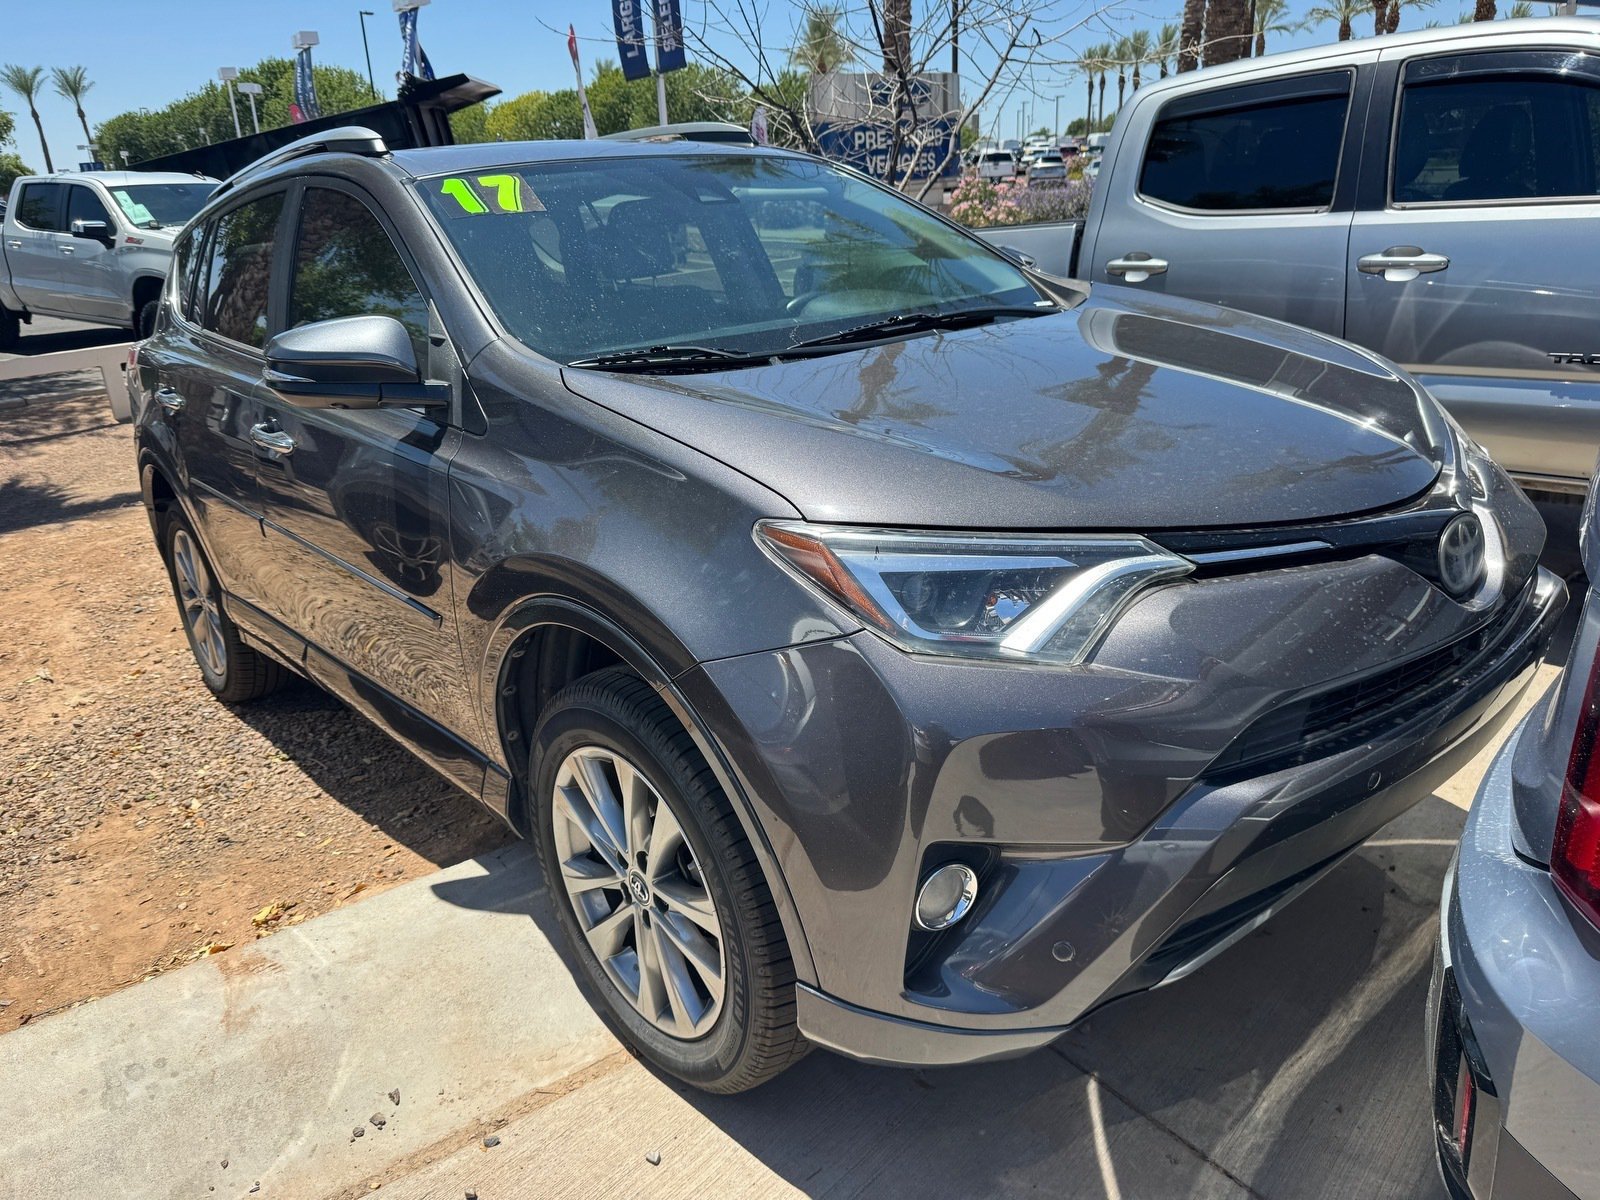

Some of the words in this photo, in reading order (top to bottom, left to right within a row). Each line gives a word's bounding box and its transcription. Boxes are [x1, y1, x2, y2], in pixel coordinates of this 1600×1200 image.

[619, 0, 640, 58] LARG
[854, 128, 943, 149] PRE-WNED
[441, 174, 523, 214] 17
[720, 904, 744, 1024] MICHELIN
